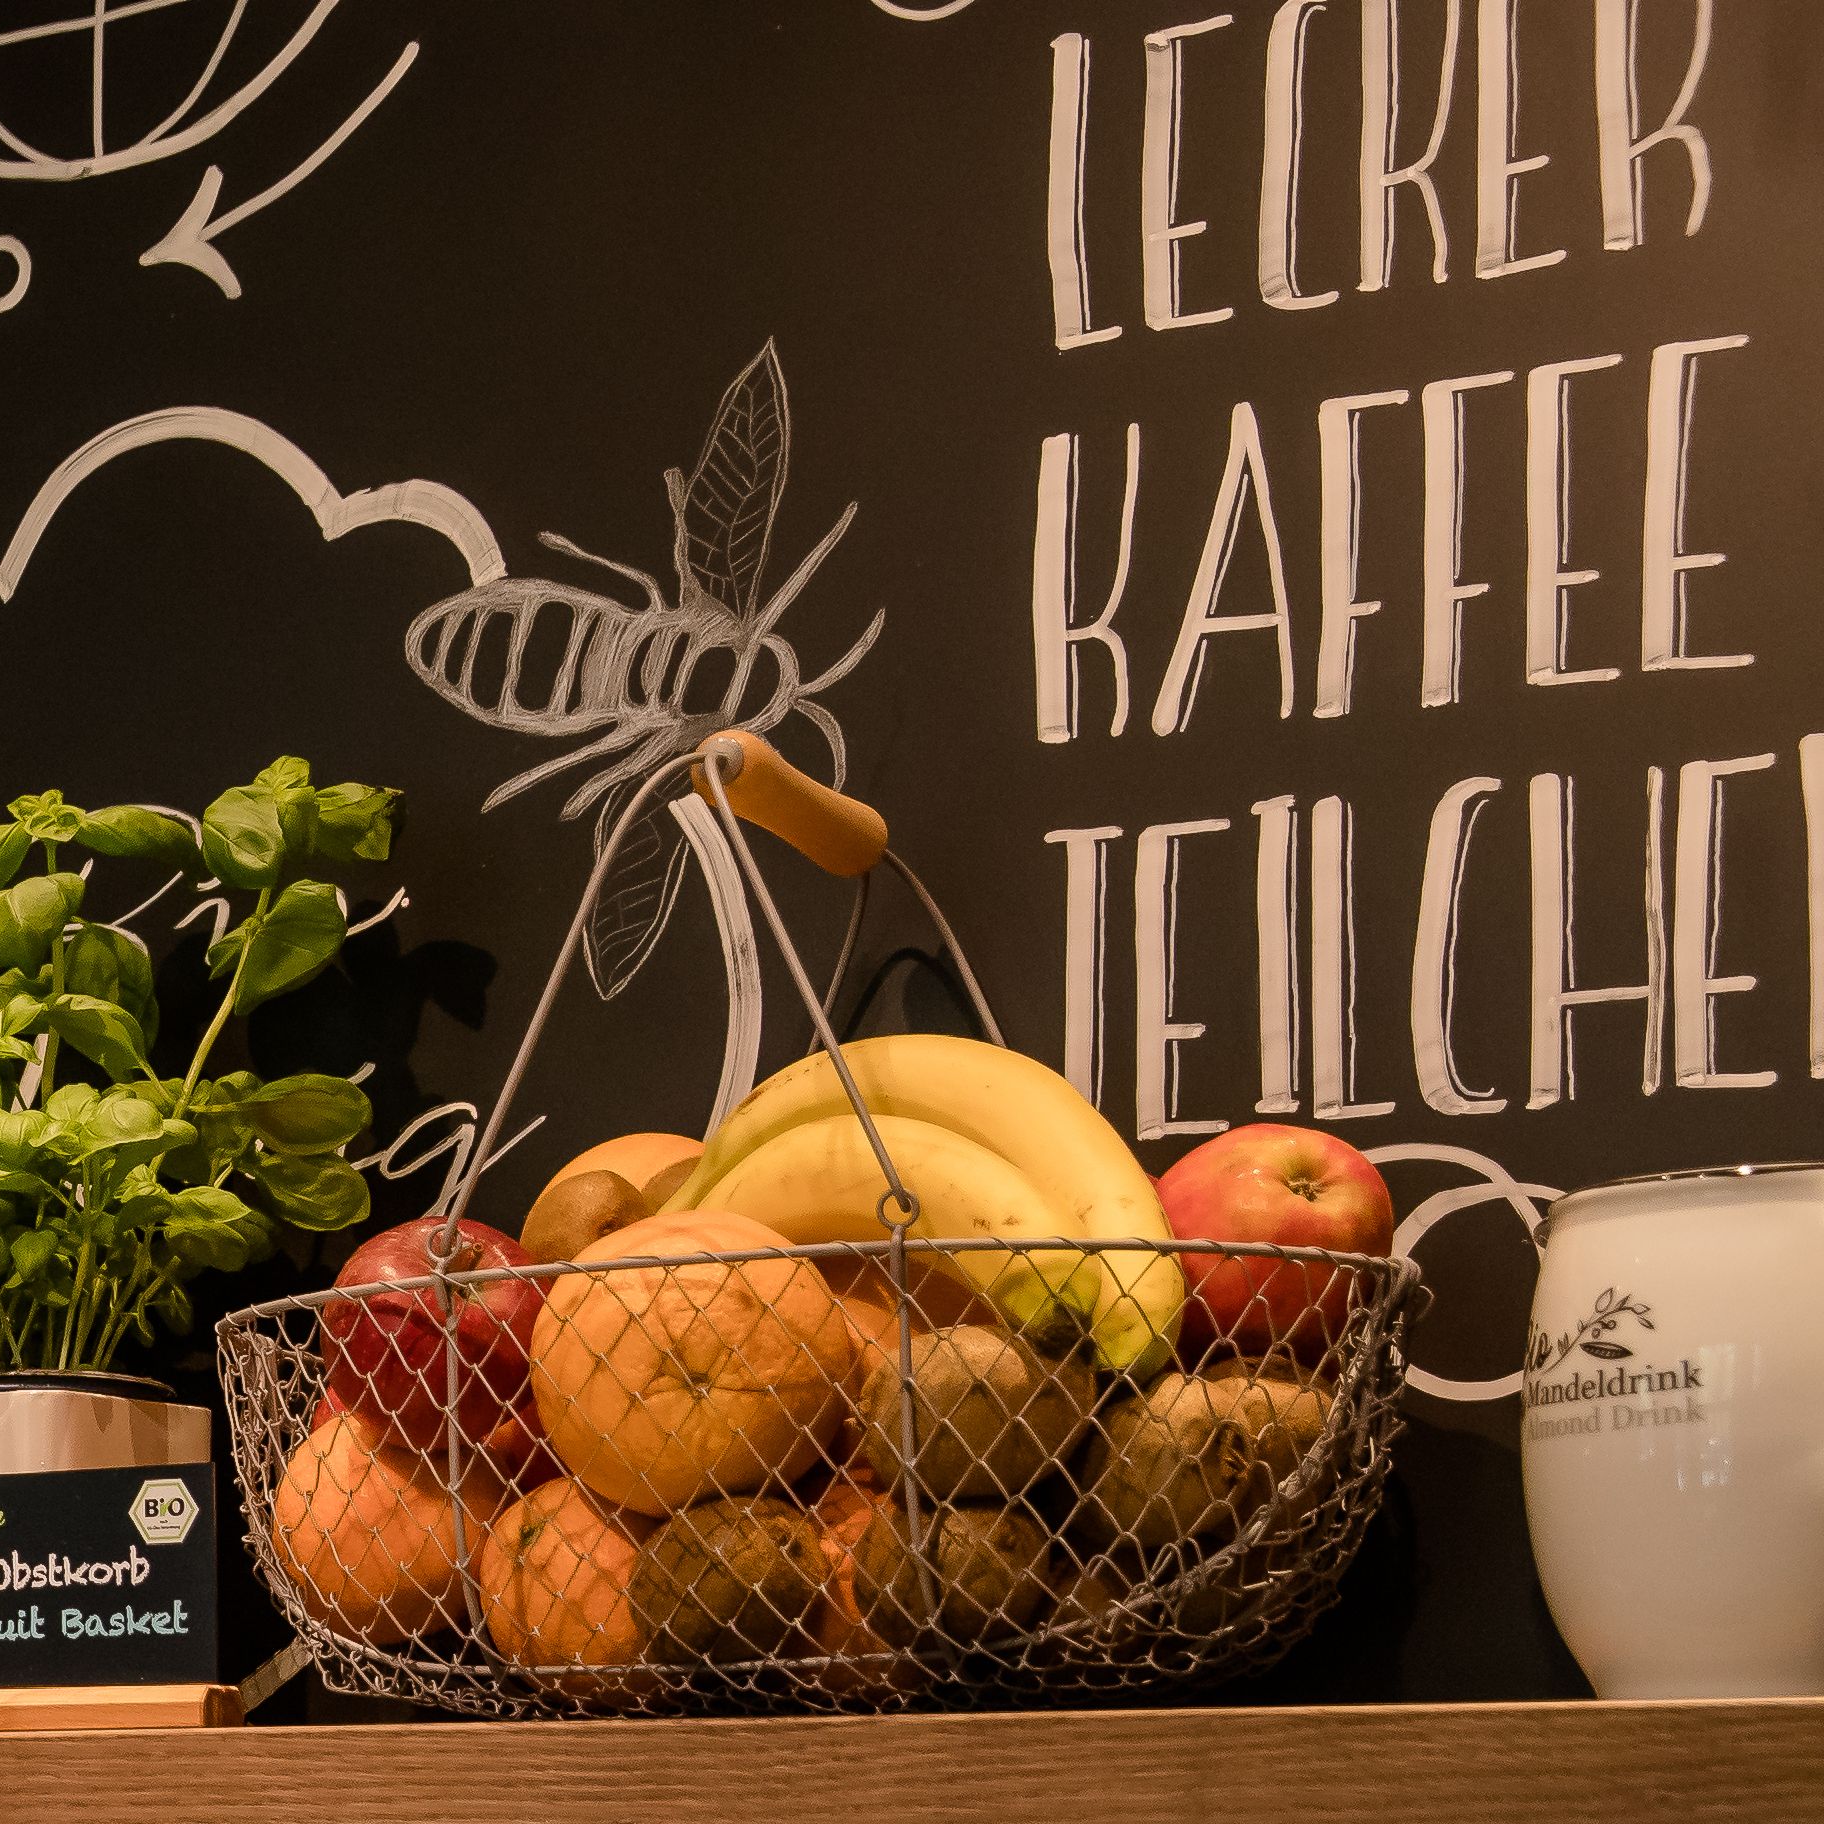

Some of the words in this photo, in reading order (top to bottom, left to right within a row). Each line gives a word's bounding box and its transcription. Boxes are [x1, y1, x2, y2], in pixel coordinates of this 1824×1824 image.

[1046, 0, 1714, 351] LECKER
[1033, 333, 1756, 744] KAFFEE
[1044, 731, 1824, 1142] TEILCHE
[60, 1599, 190, 1640] Basket
